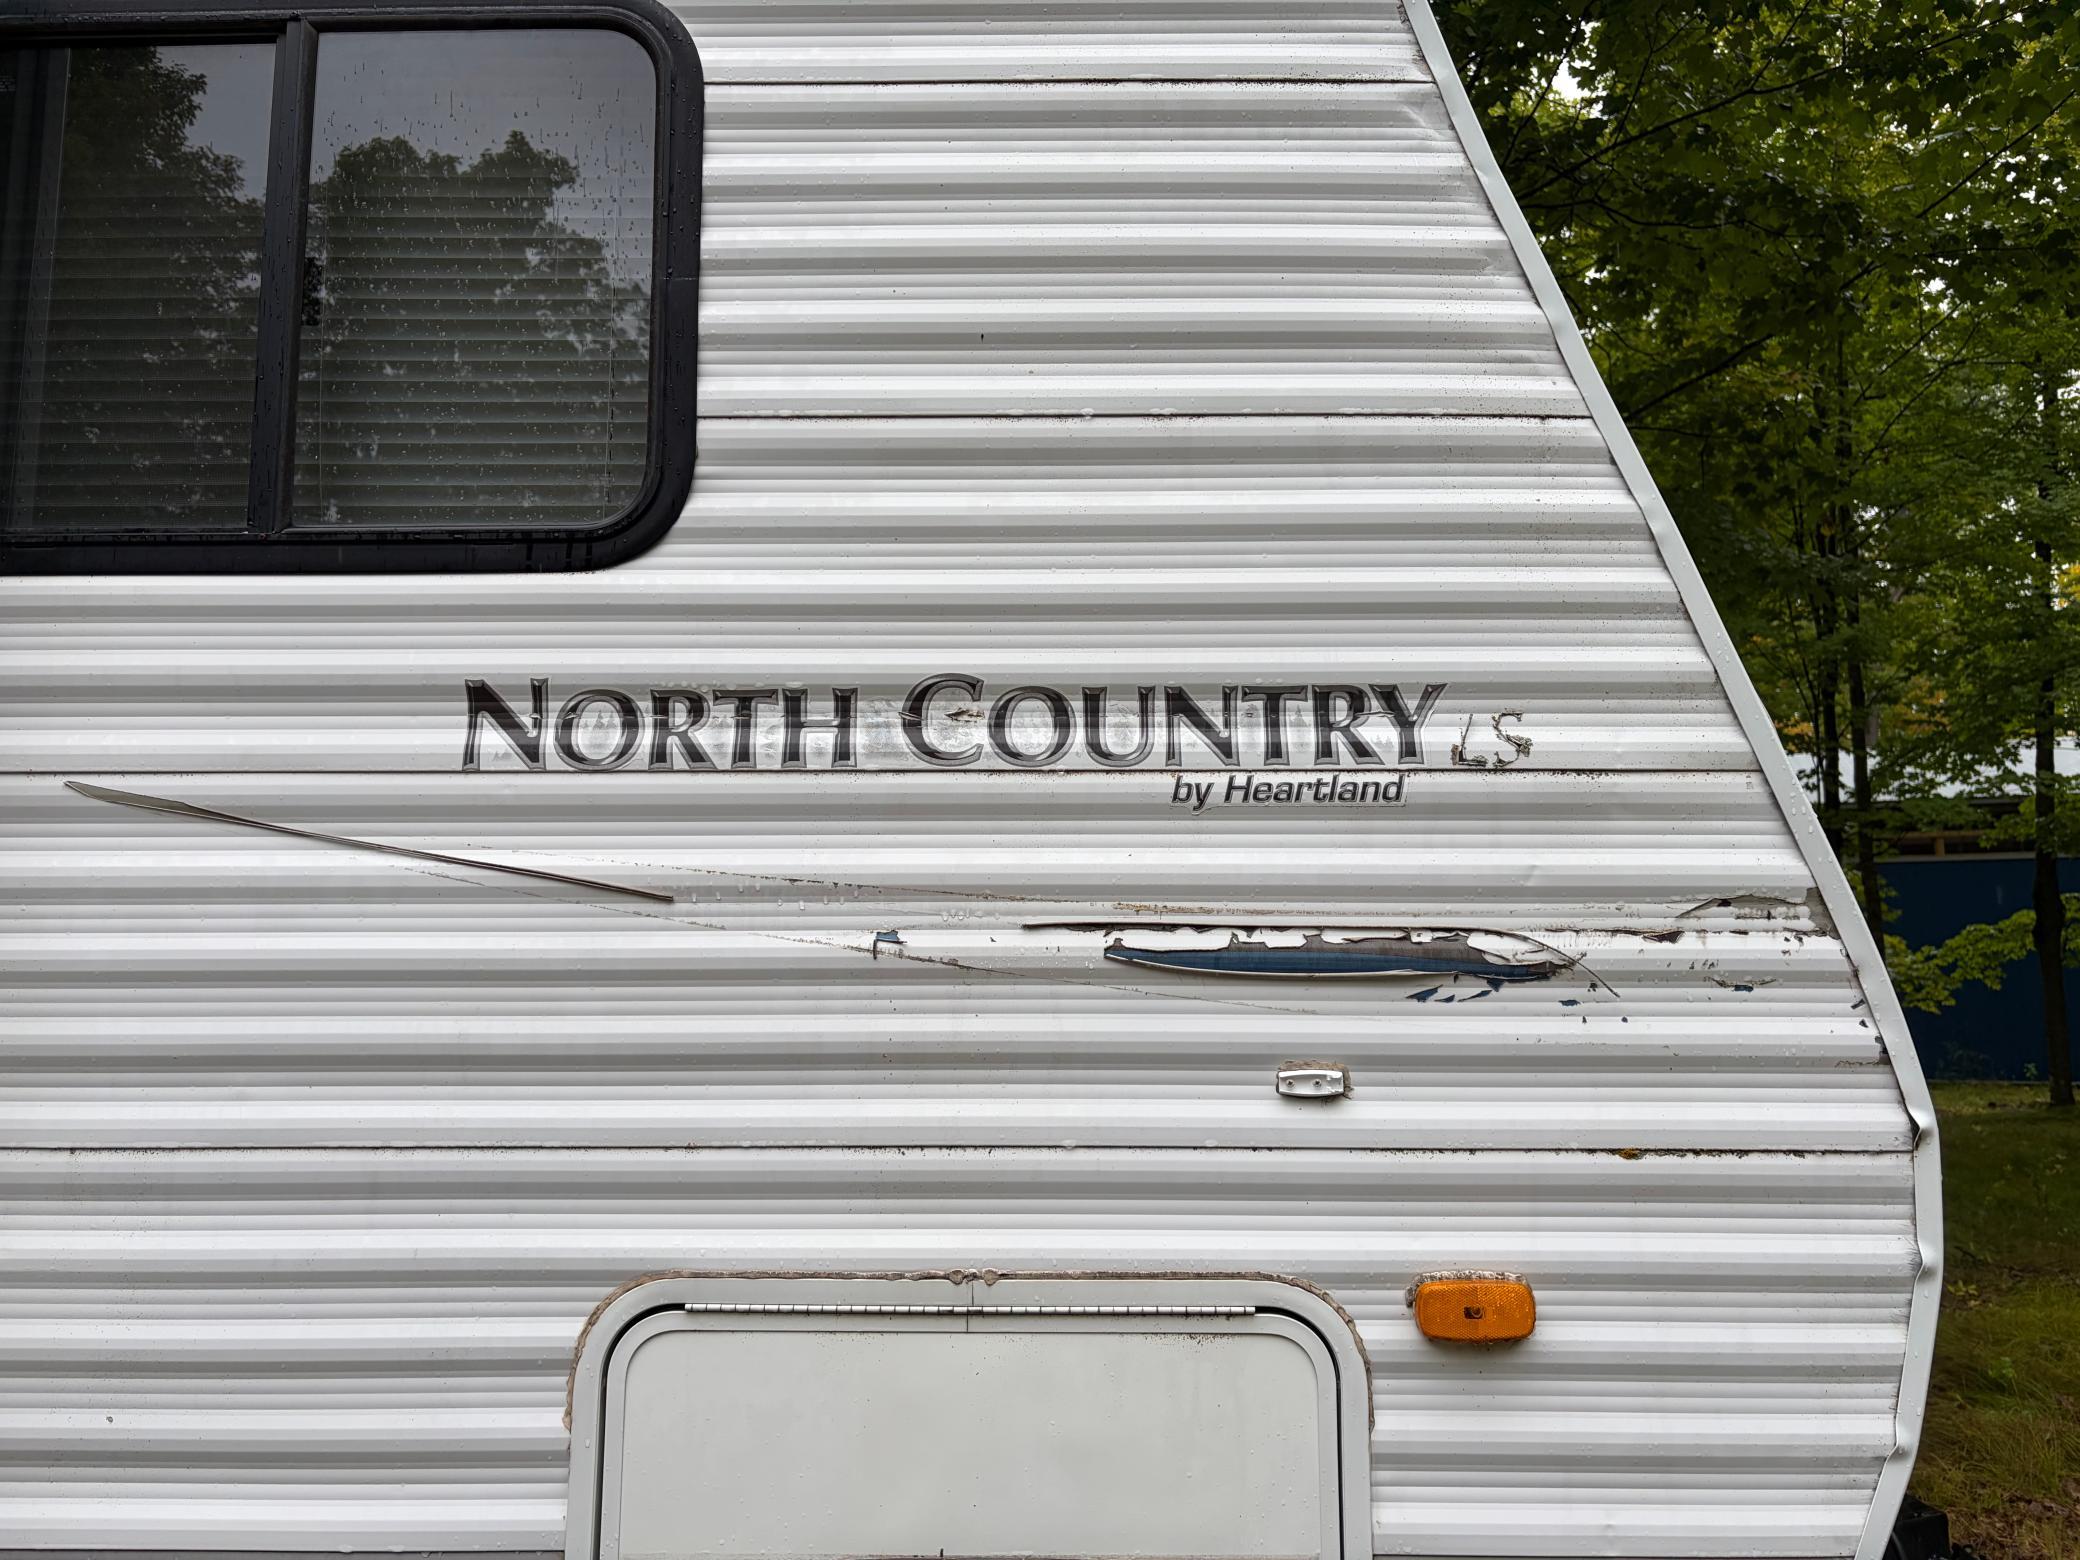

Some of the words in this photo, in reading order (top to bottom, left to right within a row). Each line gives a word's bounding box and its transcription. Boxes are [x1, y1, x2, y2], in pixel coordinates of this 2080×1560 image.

[462, 677, 859, 772] NORTH
[901, 672, 1448, 768] COUNTRY
[1172, 774, 1214, 812] by
[1223, 773, 1405, 804] Heartland
